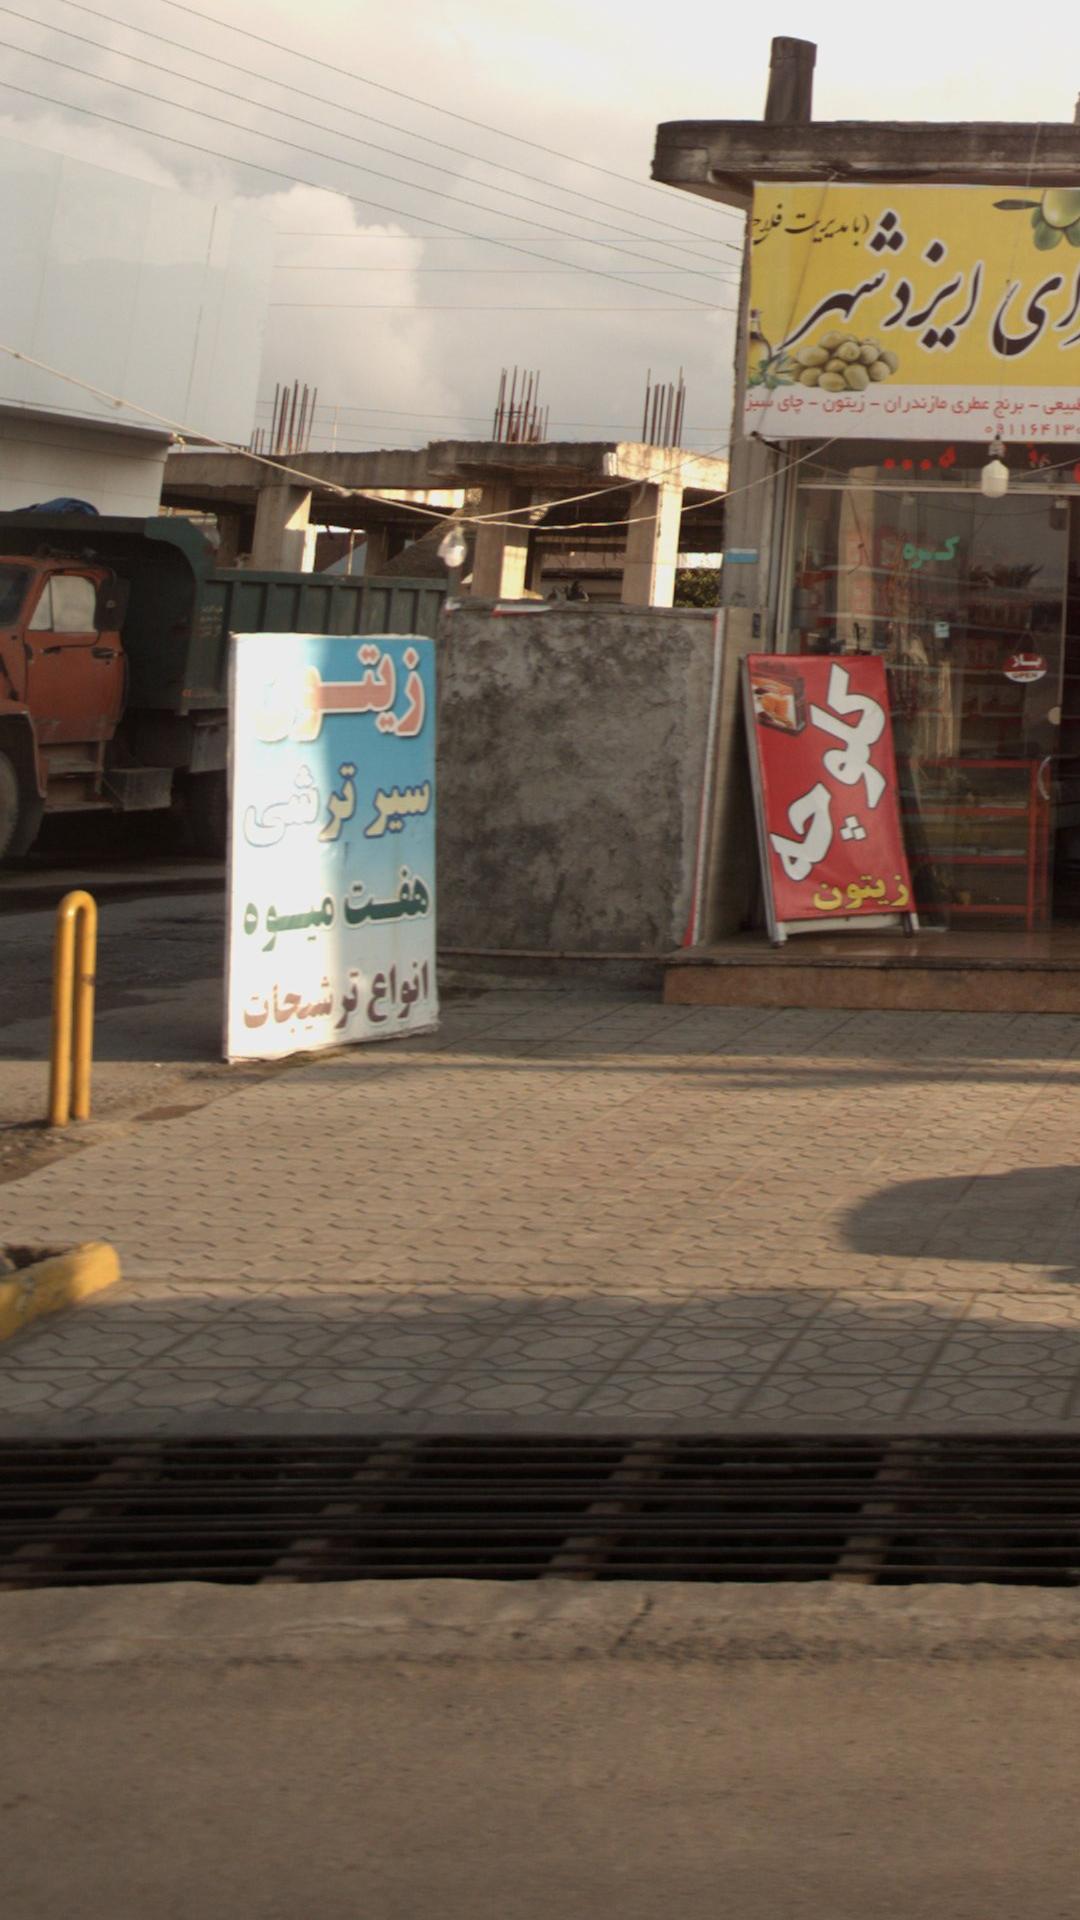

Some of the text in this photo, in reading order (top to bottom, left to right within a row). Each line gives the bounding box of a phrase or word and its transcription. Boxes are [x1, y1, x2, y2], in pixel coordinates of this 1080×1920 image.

[784, 213, 848, 242] مدیریت
[776, 211, 982, 350] ایزدشهر
[744, 394, 1080, 418] بیعی برنج عطری مازندران زیتون چای سبز
[1011, 653, 1042, 670] باز
[243, 762, 431, 848] سیر ترشی
[769, 661, 888, 882] کلوچه
[243, 864, 430, 953] هفت میوه
[813, 874, 910, 912] زیتون
[243, 960, 430, 1035] انواع ترشیجات
